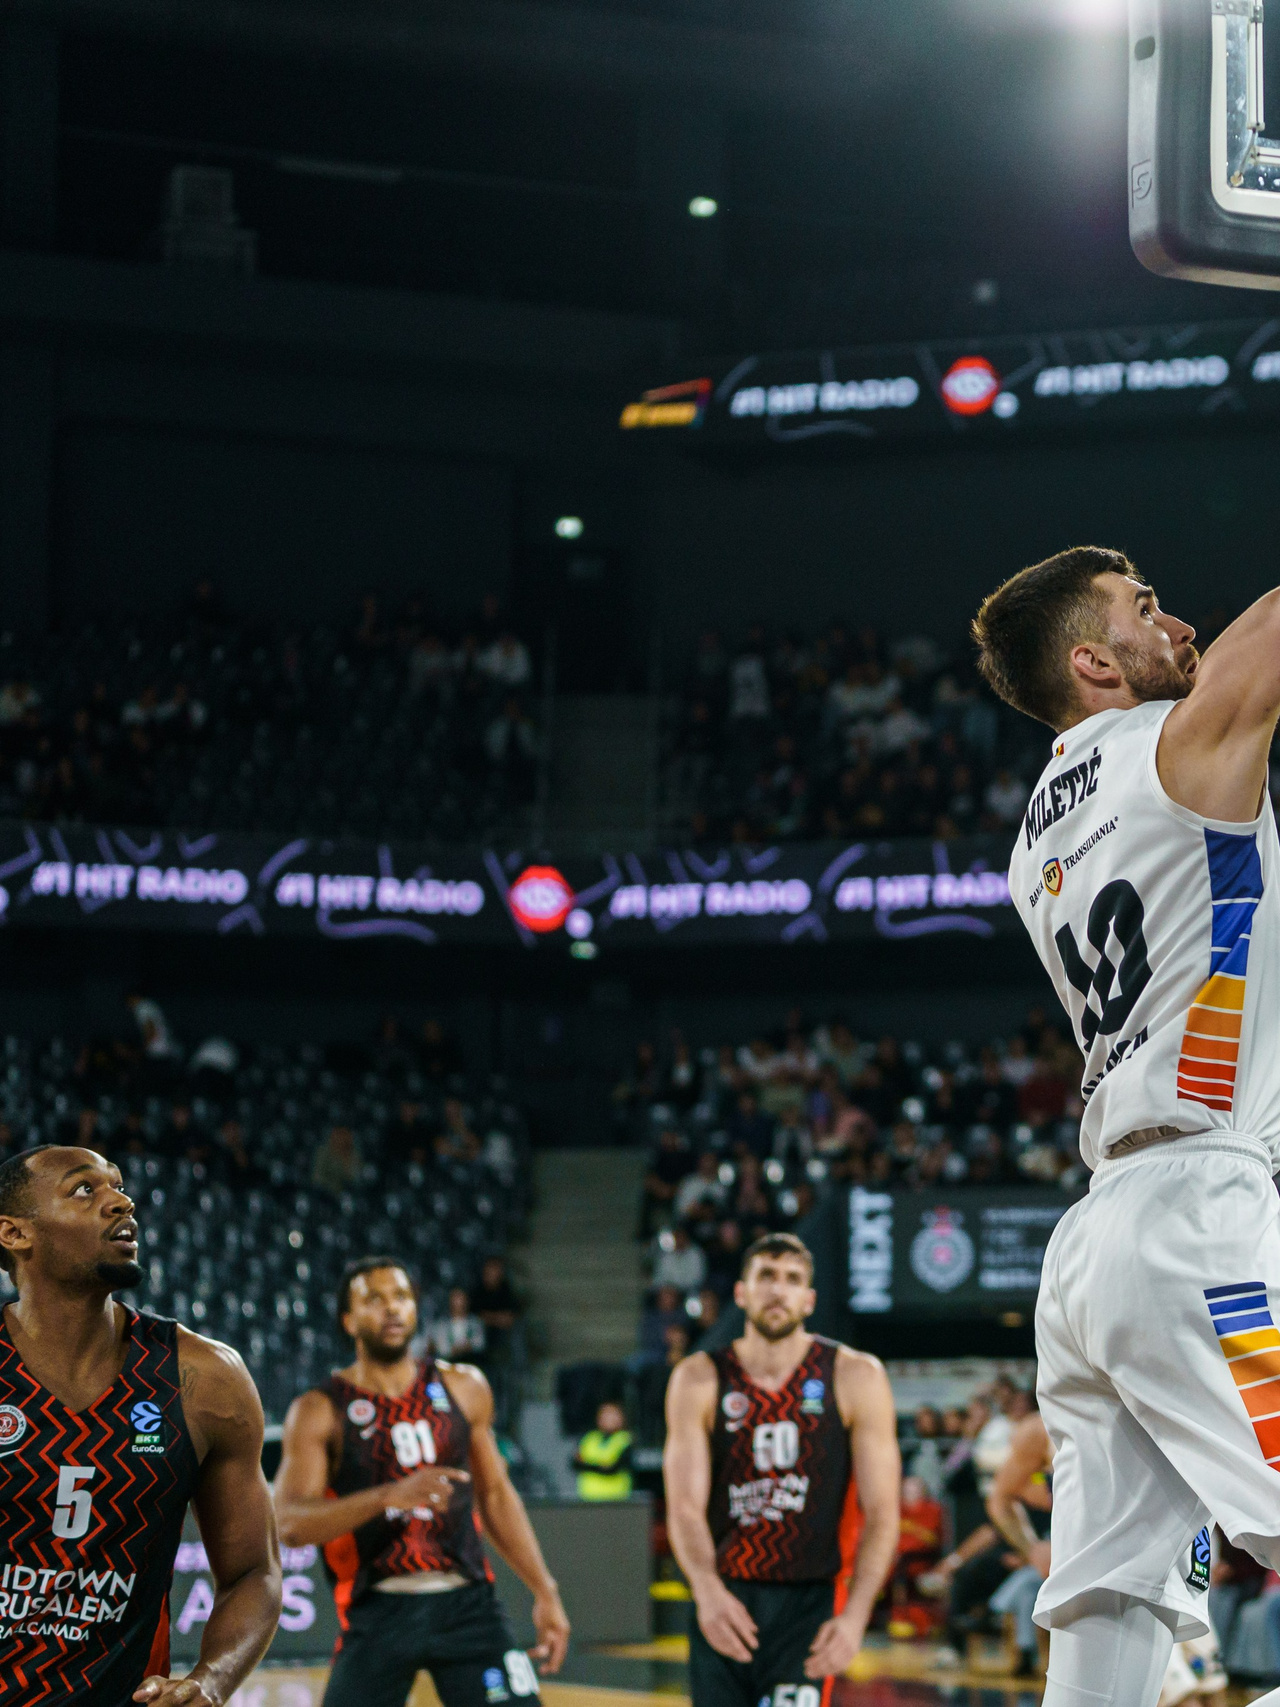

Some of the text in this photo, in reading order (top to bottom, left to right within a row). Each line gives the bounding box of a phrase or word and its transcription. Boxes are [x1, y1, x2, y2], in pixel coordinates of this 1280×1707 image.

[1025, 746, 1101, 851] MILETIĆ
[1045, 866, 1058, 883] BT
[131, 1445, 164, 1454] EuroCup
[52, 1465, 96, 1539] 5
[2, 1564, 136, 1597] IDTOWN
[0, 1591, 128, 1623] RUSALEM
